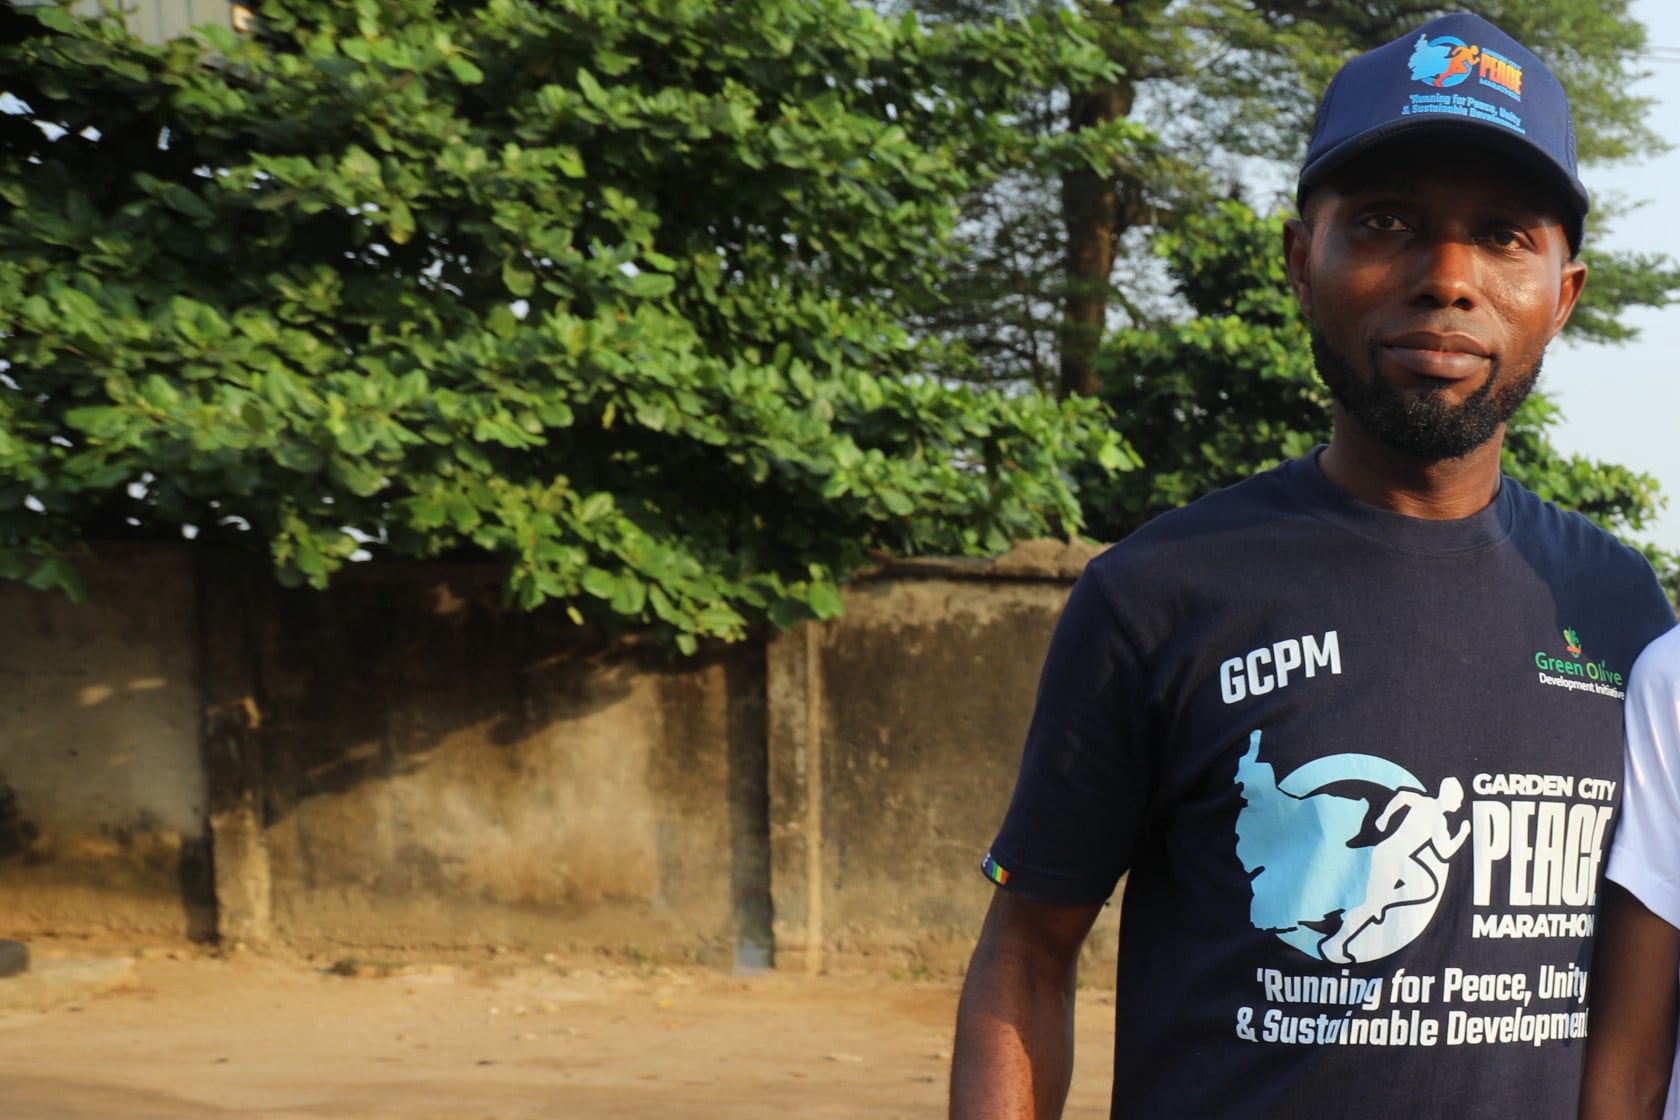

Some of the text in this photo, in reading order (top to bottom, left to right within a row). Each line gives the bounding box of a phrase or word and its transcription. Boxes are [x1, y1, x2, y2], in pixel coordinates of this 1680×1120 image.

[1220, 630, 1342, 704] GCPM
[1535, 651, 1623, 686] Green Olive
[1539, 672, 1595, 691] Development
[1472, 773, 1617, 801] GARDEN CITY
[1472, 800, 1613, 906] PEACE
[1472, 913, 1595, 939] MARATHON
[1390, 968, 1435, 1004] for
[1443, 967, 1532, 1007] Peace,
[1538, 962, 1588, 1004] Unity
[1236, 1006, 1259, 1043] &
[1262, 1009, 1438, 1046] Sustainable
